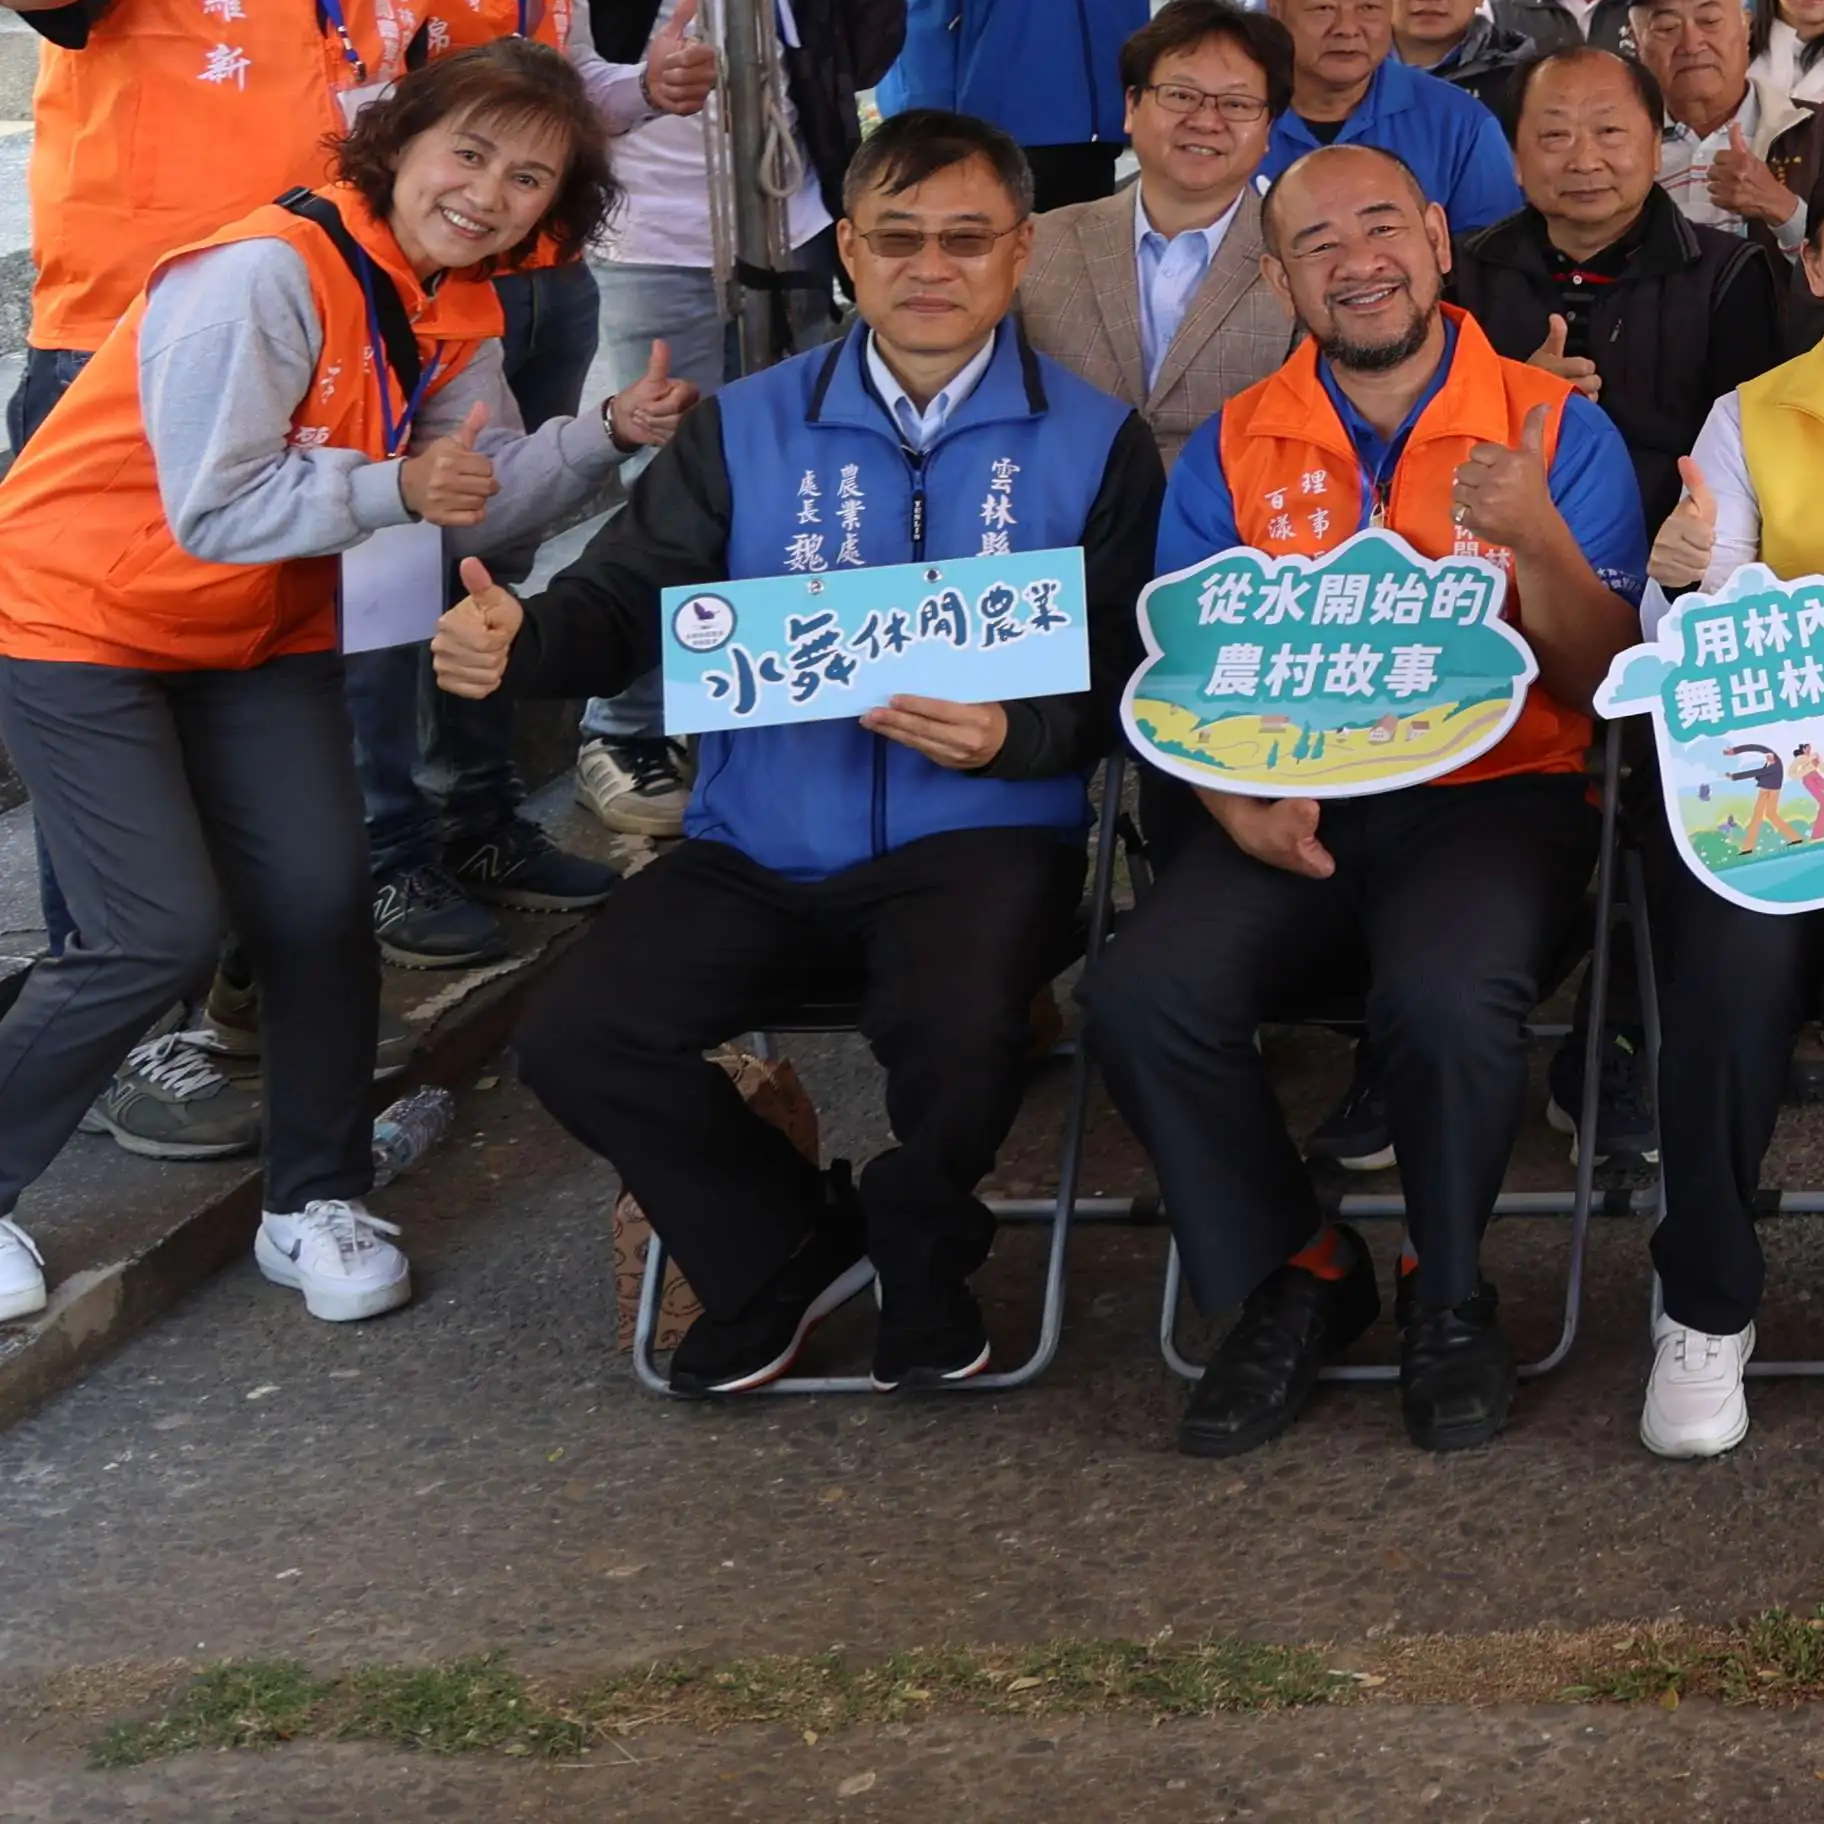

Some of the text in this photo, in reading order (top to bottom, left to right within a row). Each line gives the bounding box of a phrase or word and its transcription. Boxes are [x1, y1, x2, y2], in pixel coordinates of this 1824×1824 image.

[835, 463, 867, 566] 農業處
[1301, 469, 1331, 562] 理事
[1197, 572, 1487, 626] 從水開始的
[706, 580, 1070, 715] 水舞休閒農業
[1204, 643, 1442, 698] 農村故事
